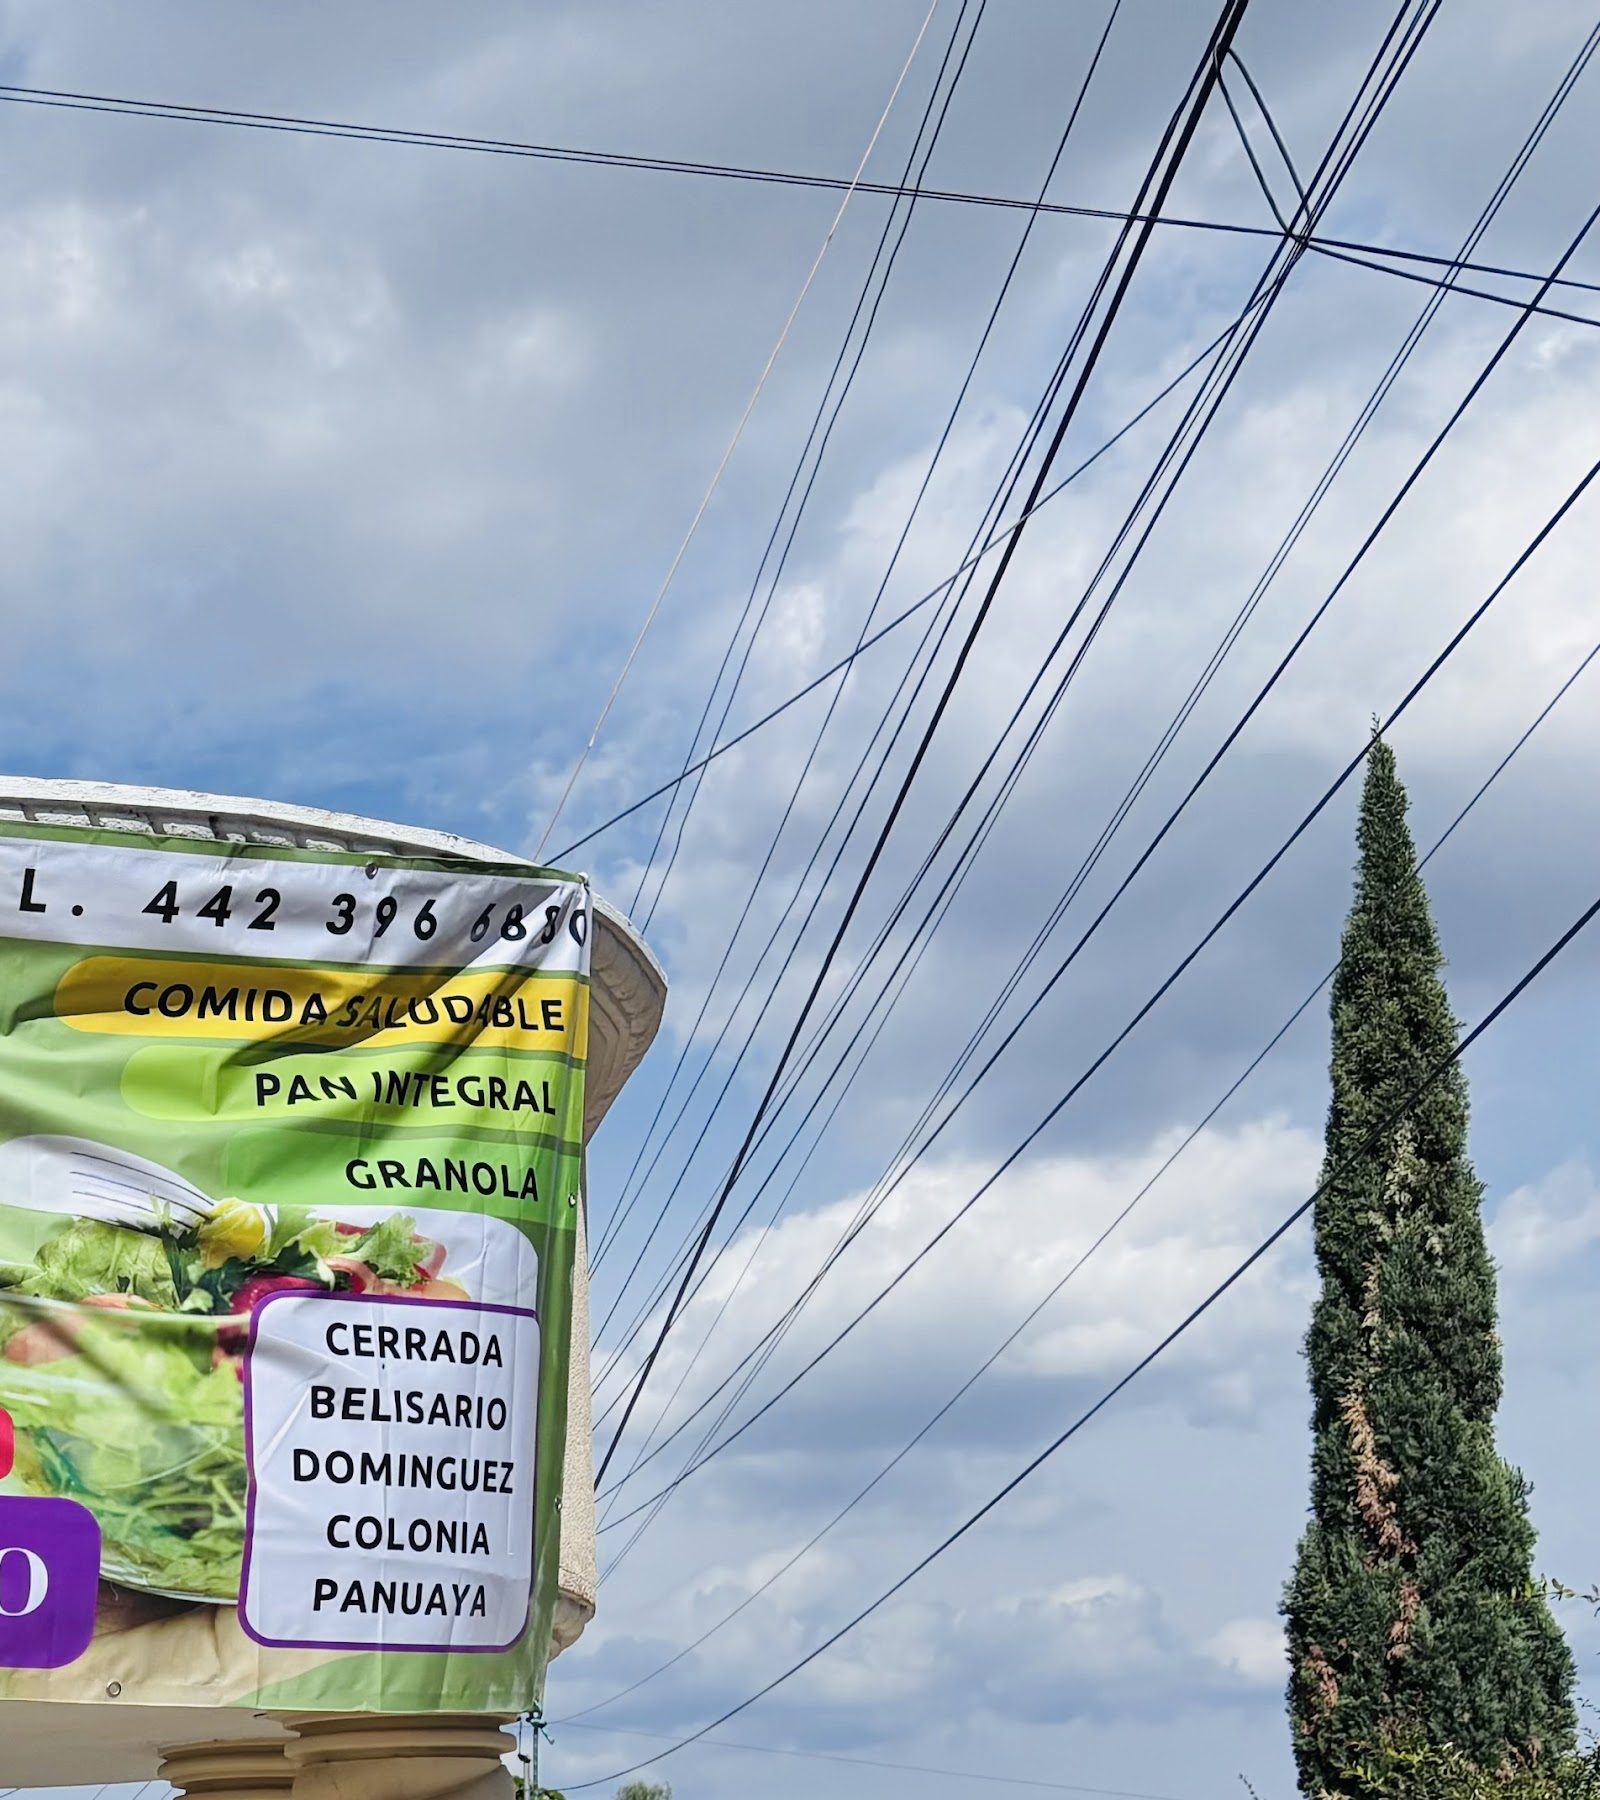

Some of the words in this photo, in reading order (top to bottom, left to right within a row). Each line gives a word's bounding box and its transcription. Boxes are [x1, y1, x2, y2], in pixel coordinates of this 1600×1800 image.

[143, 880, 282, 931] 442
[326, 893, 438, 942] 396
[470, 903, 588, 948] 6880
[123, 981, 328, 1026] COMIDA
[335, 994, 566, 1032] SALUDABLE
[255, 1072, 357, 1107] PAN
[373, 1070, 558, 1116] INTEGRAL
[346, 1158, 539, 1202] GRANOLA
[325, 1322, 503, 1368] CERRADA
[310, 1385, 508, 1431] BELISARIO
[292, 1448, 514, 1494] DOMINGUEZ
[326, 1514, 490, 1556] COLONIA
[312, 1578, 487, 1618] PANUAYA
